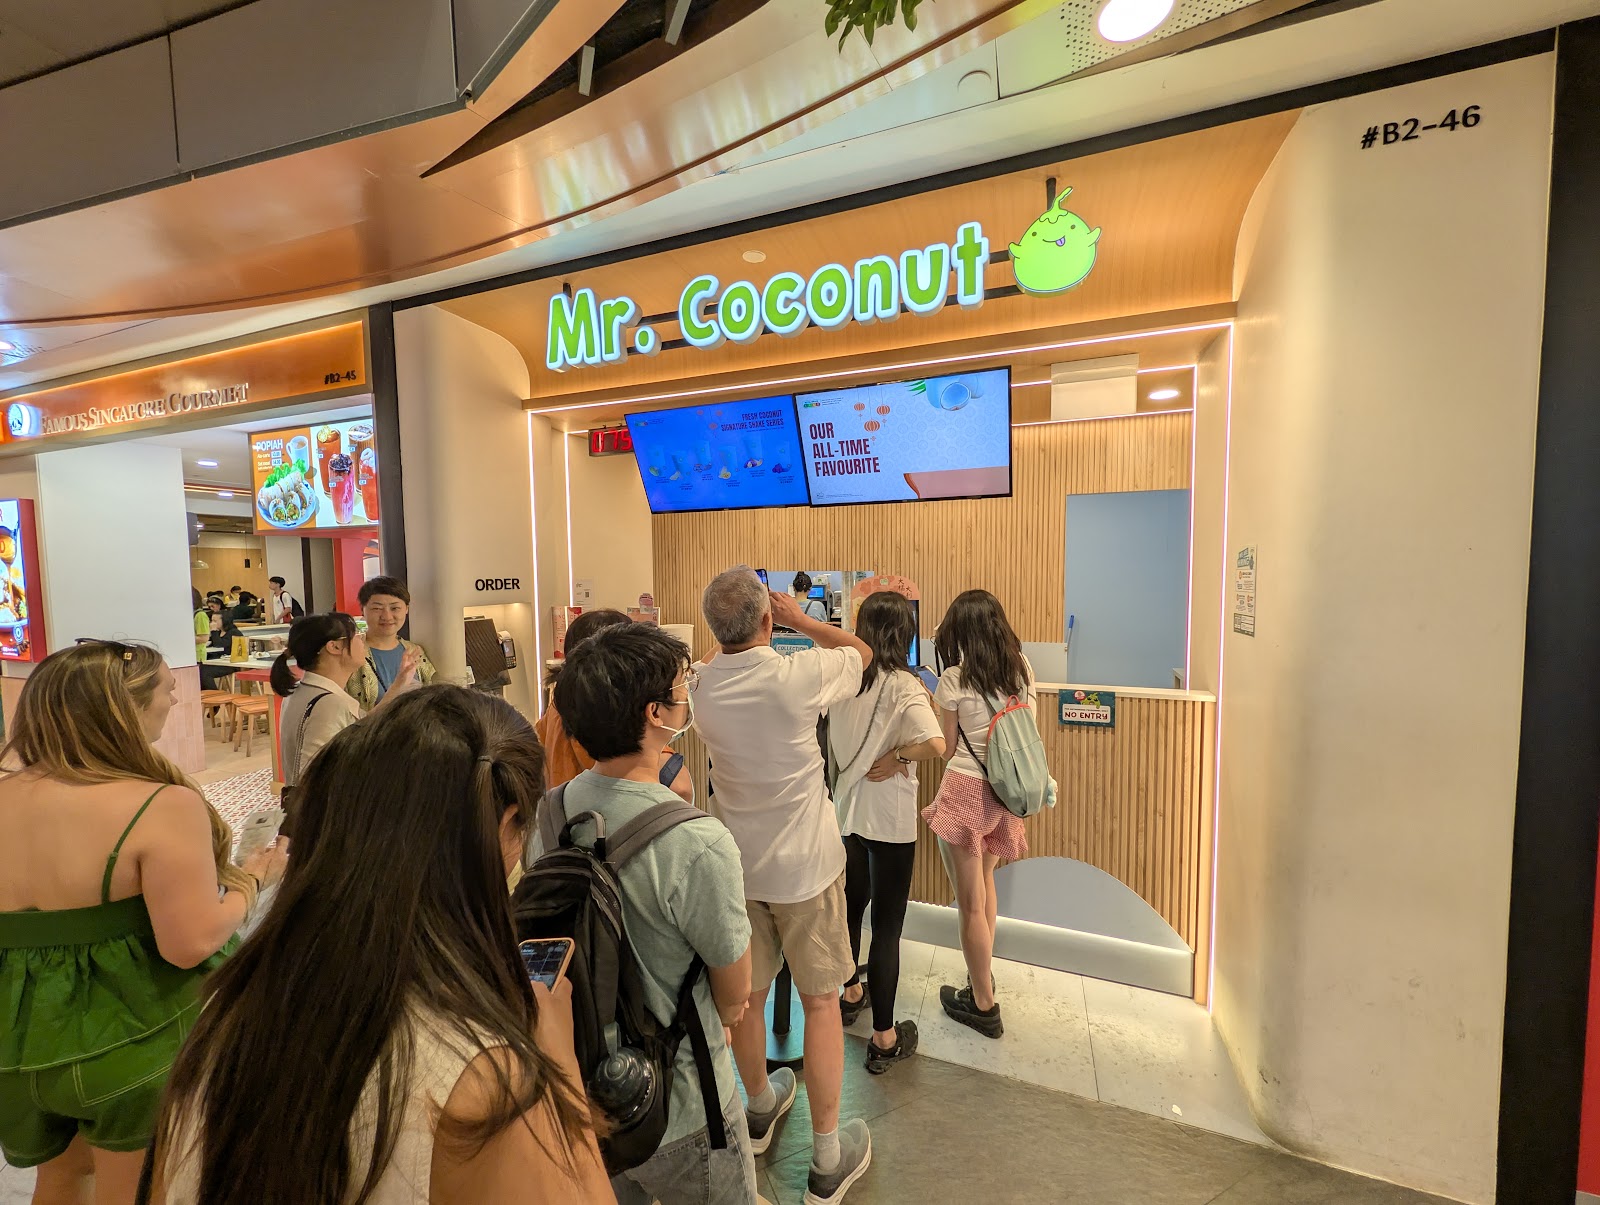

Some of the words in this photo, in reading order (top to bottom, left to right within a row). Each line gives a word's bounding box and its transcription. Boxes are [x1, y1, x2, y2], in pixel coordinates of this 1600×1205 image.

[1360, 105, 1480, 149] #B2-46
[546, 287, 660, 372] Mr.
[679, 220, 989, 350] Coconut
[324, 370, 356, 384] #B2-45
[88, 399, 167, 426] SINGAPORE
[742, 412, 758, 421] FRESH
[759, 409, 782, 419] COCONUT
[721, 422, 748, 431] SIGNATURE
[748, 420, 765, 429] SHAKE
[766, 418, 784, 427] SERIES
[809, 422, 835, 440] OUR
[256, 439, 283, 451] POPIAH
[813, 438, 871, 459] ALL-TIME
[814, 457, 881, 477] FAVOURITE
[475, 578, 521, 591] ORDER
[1079, 712, 1108, 720] ENTRY
